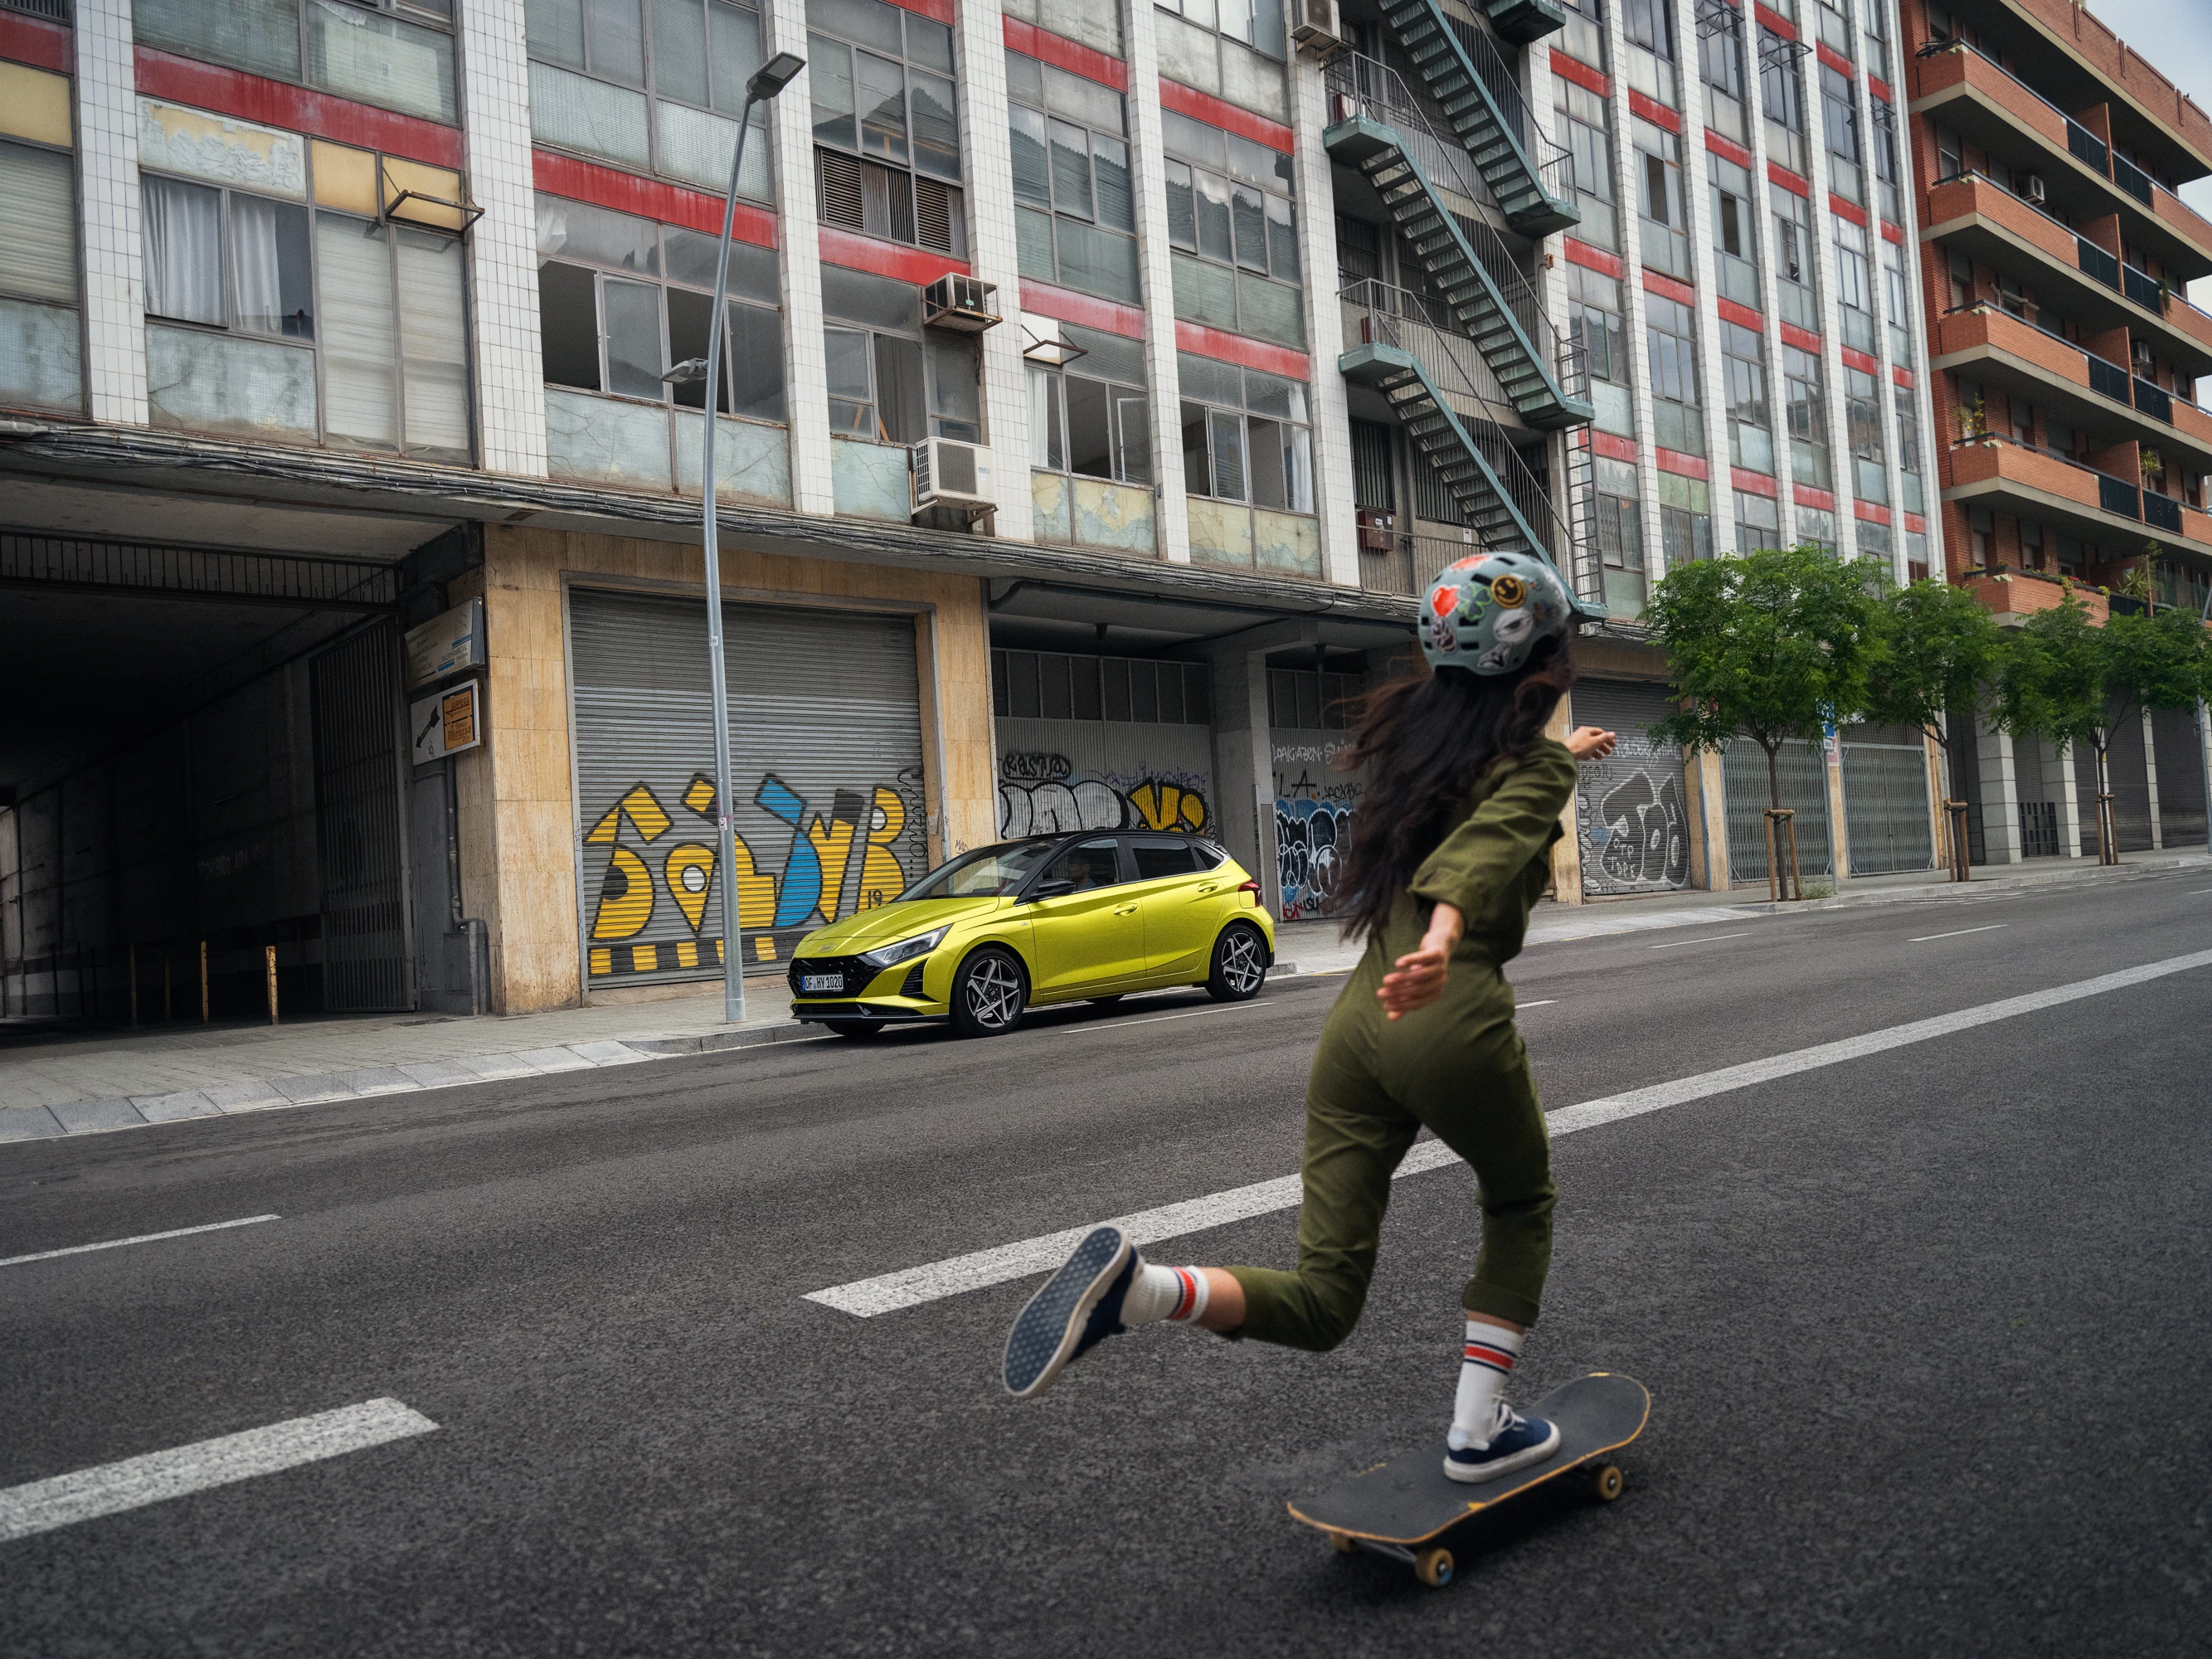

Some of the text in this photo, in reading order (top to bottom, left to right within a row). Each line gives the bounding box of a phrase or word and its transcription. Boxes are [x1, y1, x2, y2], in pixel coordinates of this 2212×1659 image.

[868, 889, 882, 909] 19
[805, 975, 843, 989] OF HY 1020
